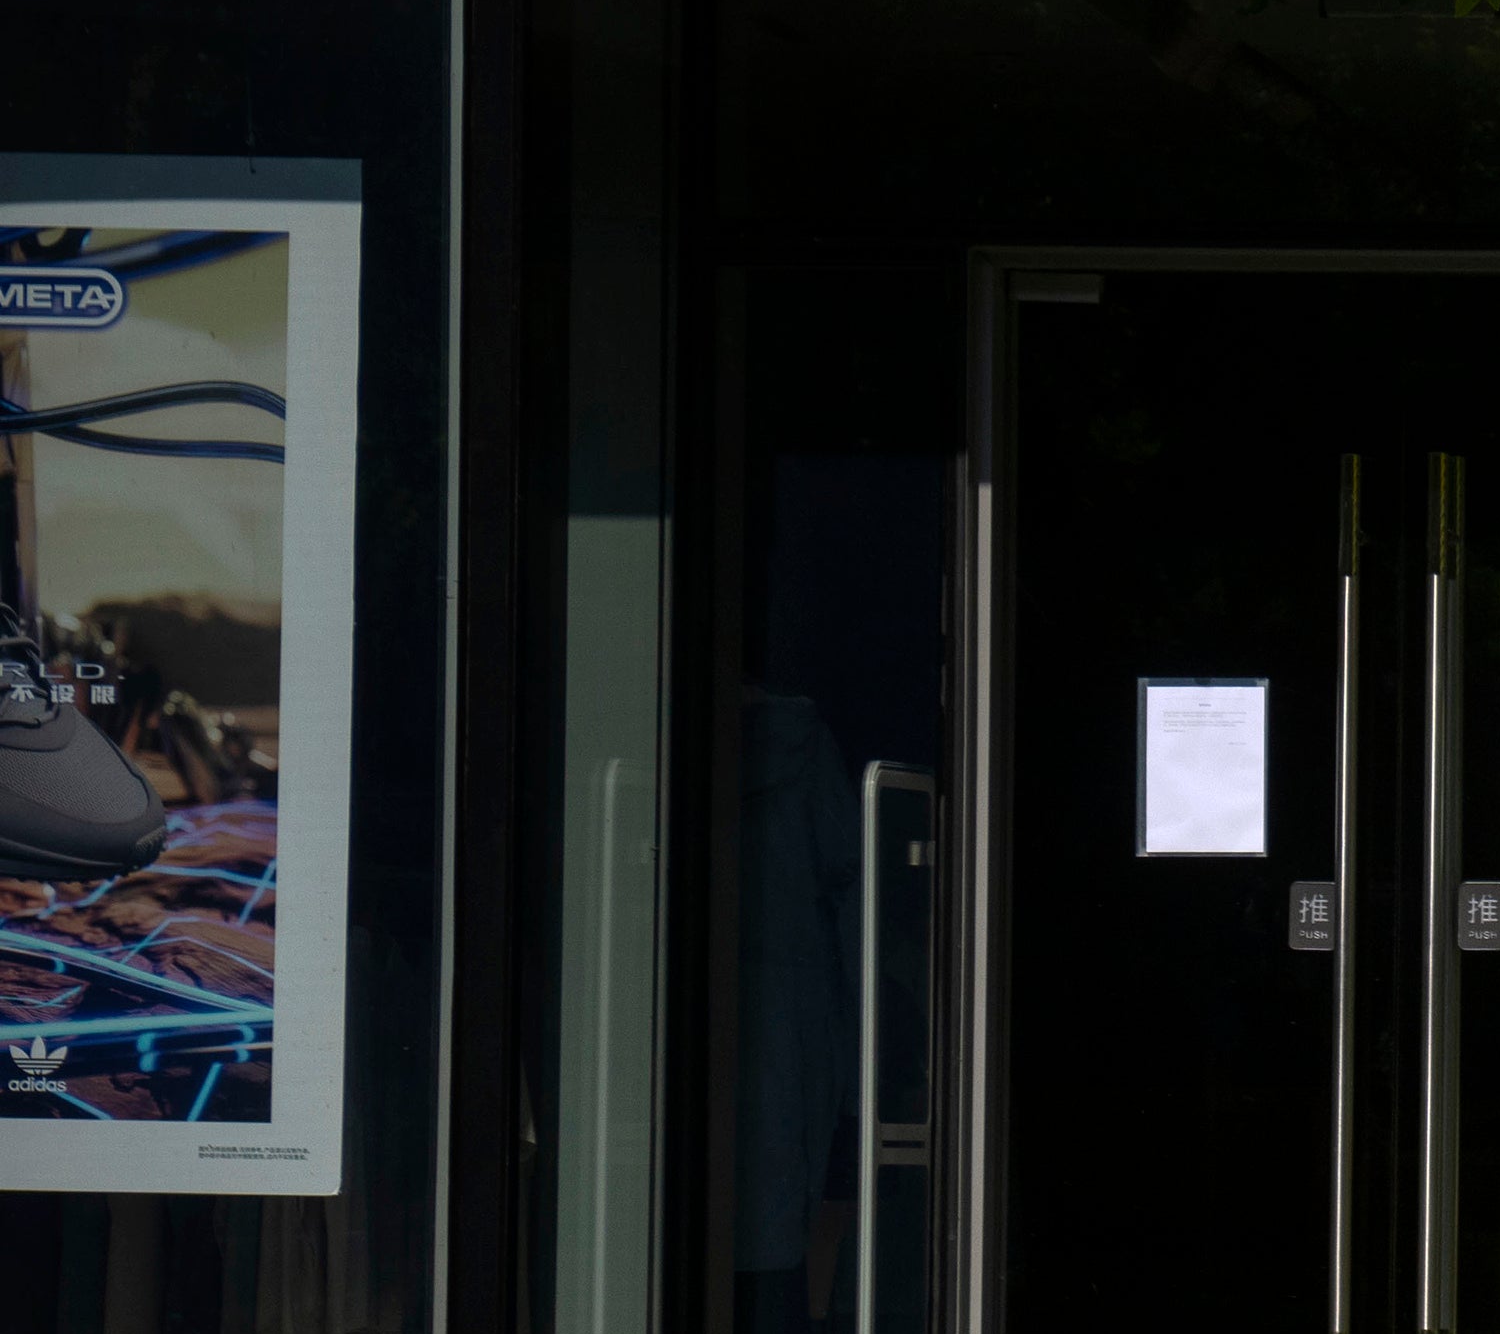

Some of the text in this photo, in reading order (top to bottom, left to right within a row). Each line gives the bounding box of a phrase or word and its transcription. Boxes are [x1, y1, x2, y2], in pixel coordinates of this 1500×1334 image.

[0, 283, 111, 309] META
[10, 684, 117, 705] 不设限
[1299, 894, 1329, 924] 推
[1467, 894, 1499, 924] 推
[1299, 930, 1329, 940] PUSH
[1468, 930, 1498, 940] PUSH
[8, 1076, 68, 1092] adidas
